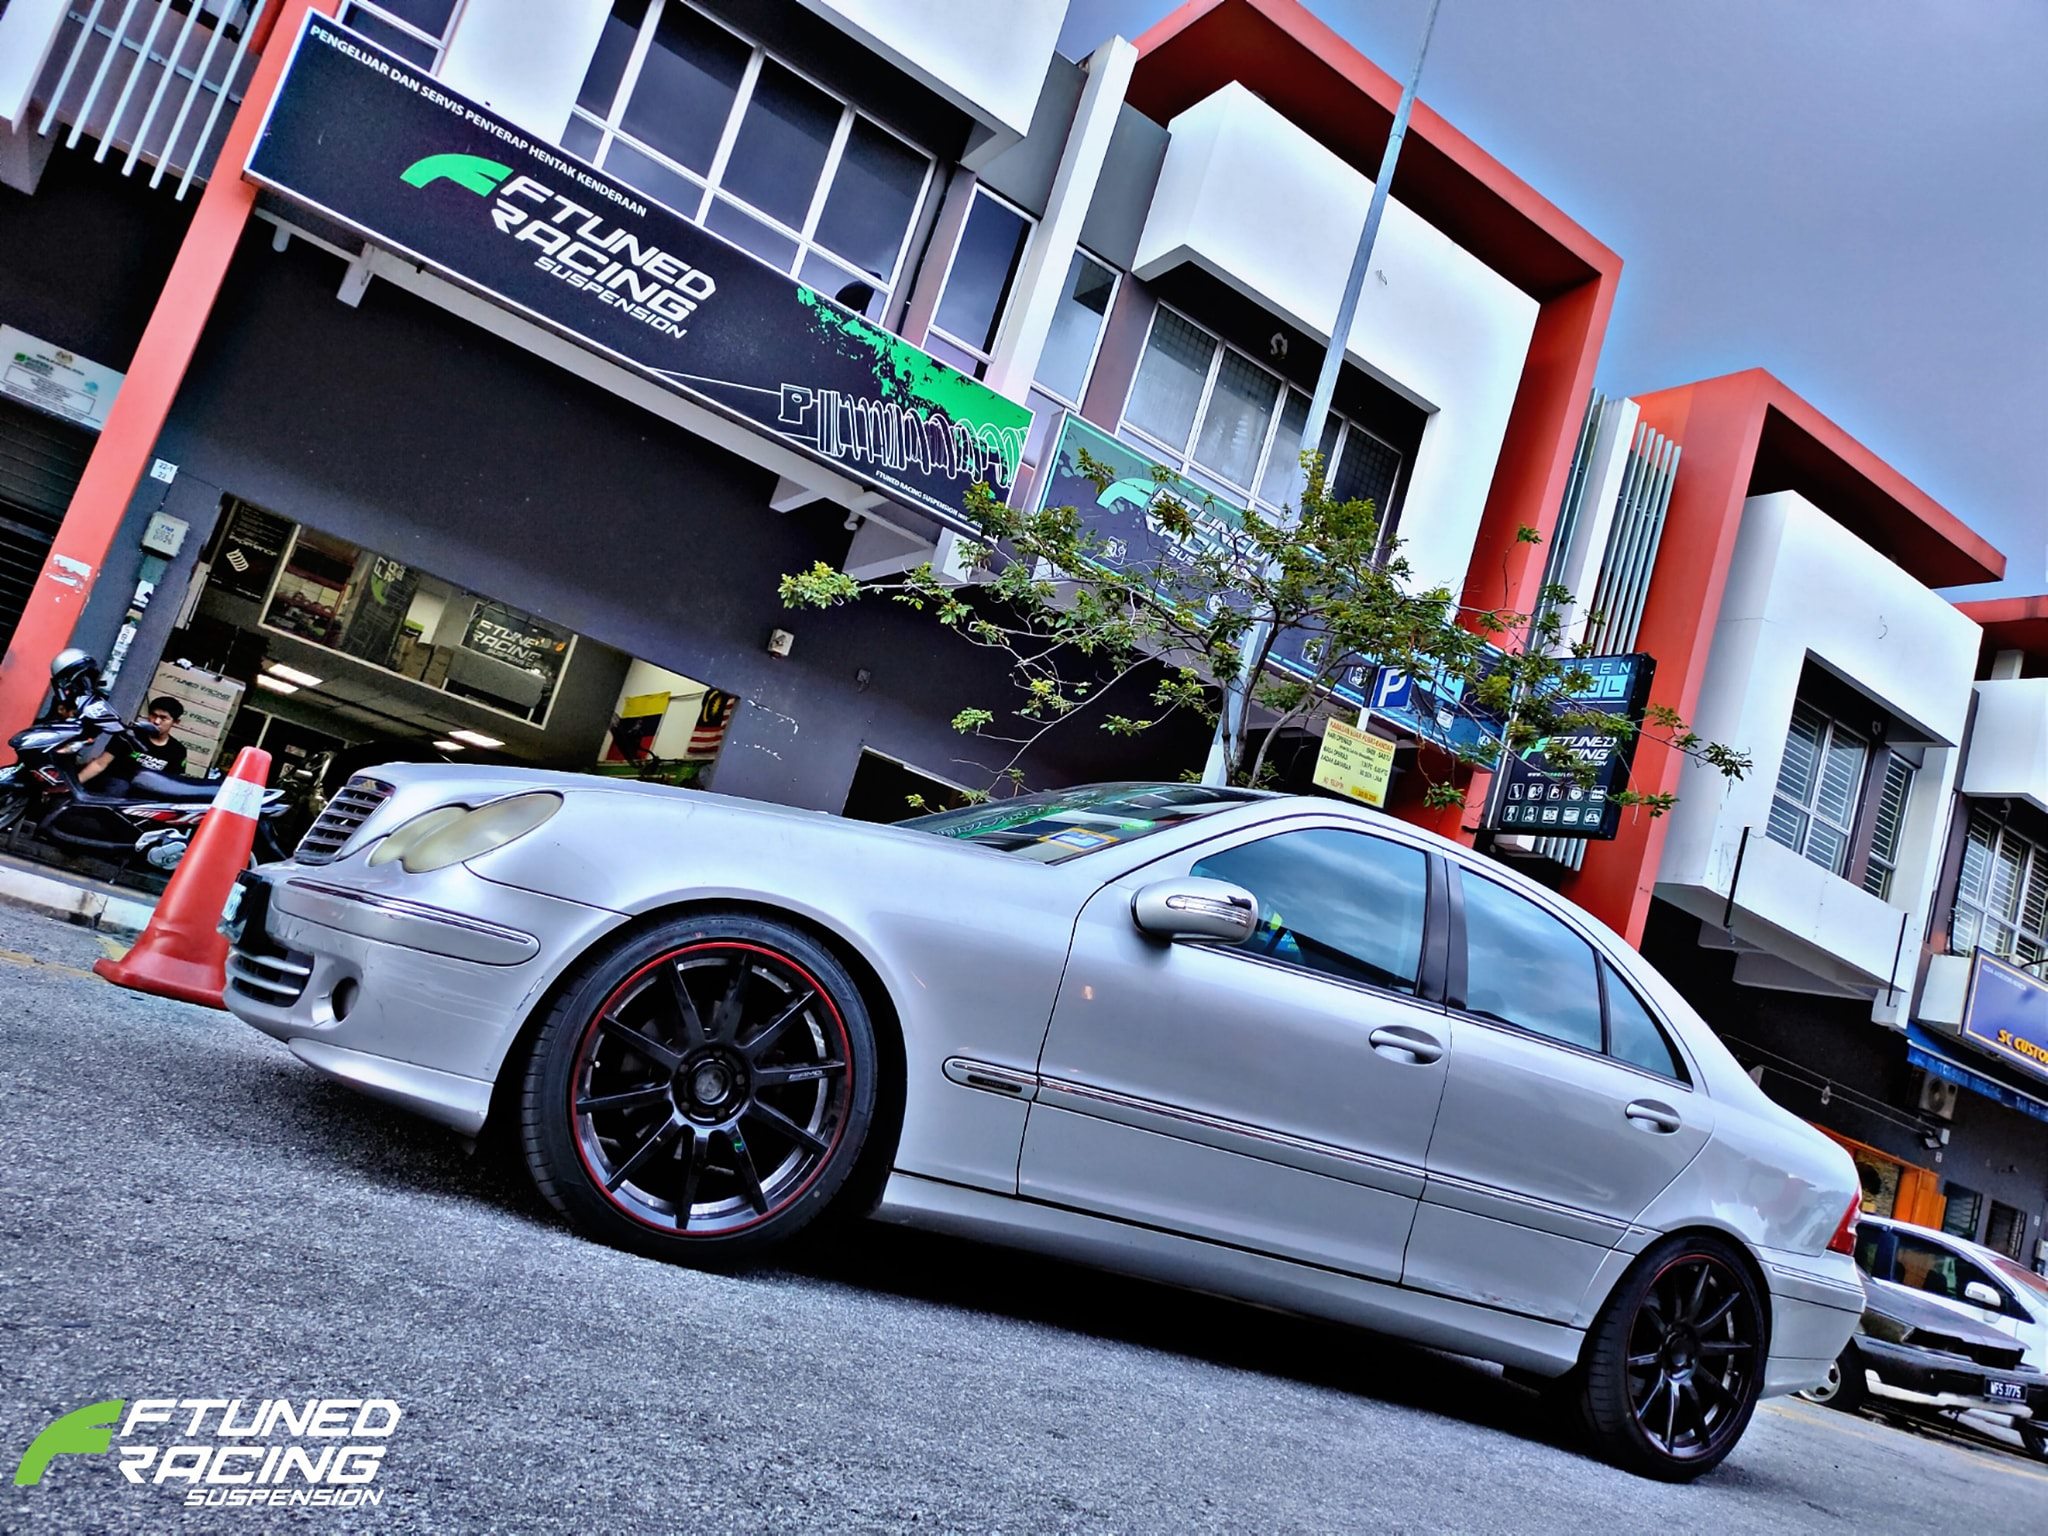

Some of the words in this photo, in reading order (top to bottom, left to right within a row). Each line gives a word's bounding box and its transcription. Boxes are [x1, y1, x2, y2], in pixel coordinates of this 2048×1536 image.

[310, 25, 390, 75] PENGELUAR
[389, 68, 420, 92] DAN
[420, 85, 465, 116] SERVIS
[465, 110, 529, 149] PENYERAP
[528, 144, 577, 178] HENTAK
[576, 171, 647, 217] KENDERAAN
[491, 198, 698, 322] RACING
[500, 175, 717, 301] FTUNED
[533, 256, 688, 339] SUSPENSION
[1377, 668, 1408, 707] P
[2013, 1036, 2048, 1064] CUSTO
